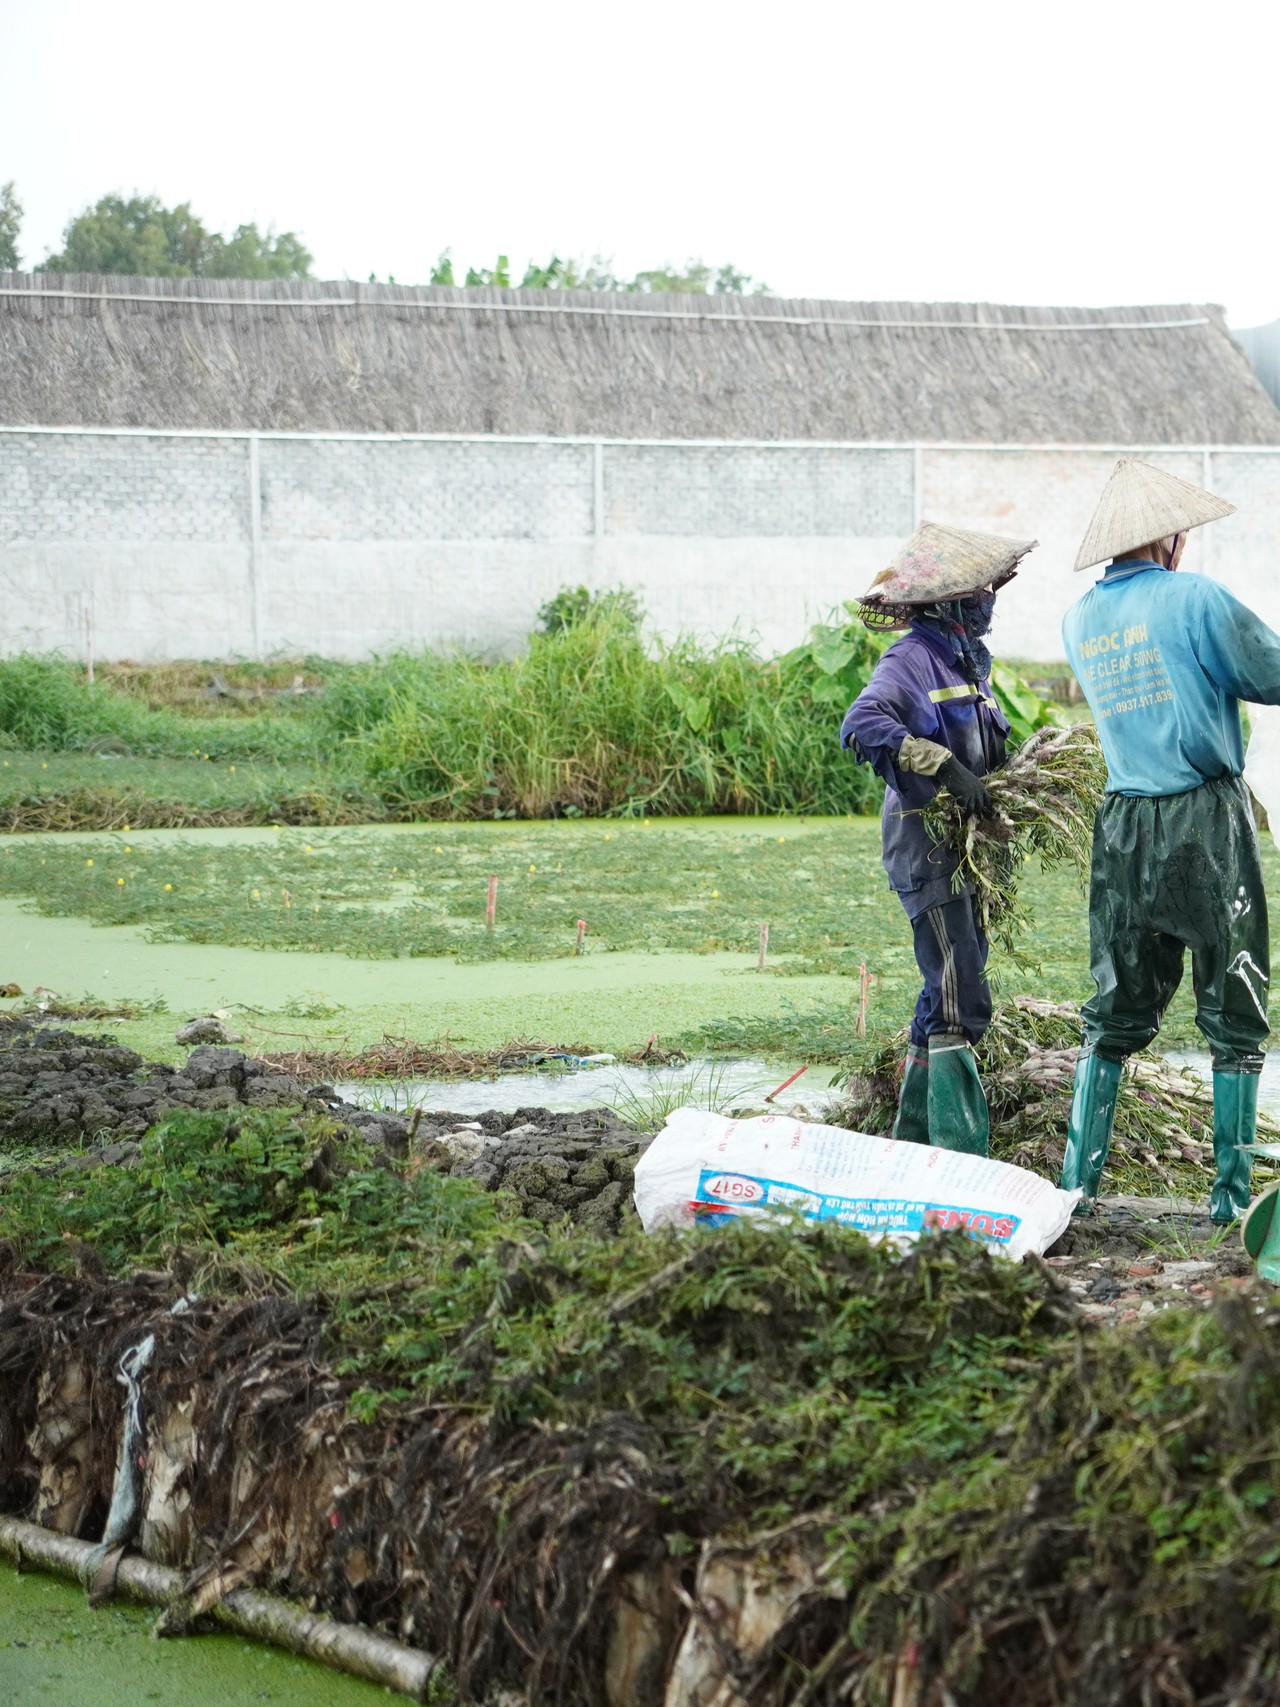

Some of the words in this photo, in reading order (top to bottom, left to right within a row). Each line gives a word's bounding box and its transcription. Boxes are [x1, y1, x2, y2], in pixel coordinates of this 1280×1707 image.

[1080, 631, 1120, 661] NGỌC
[1098, 655, 1133, 678] CLEAR
[711, 1180, 756, 1198] SG17
